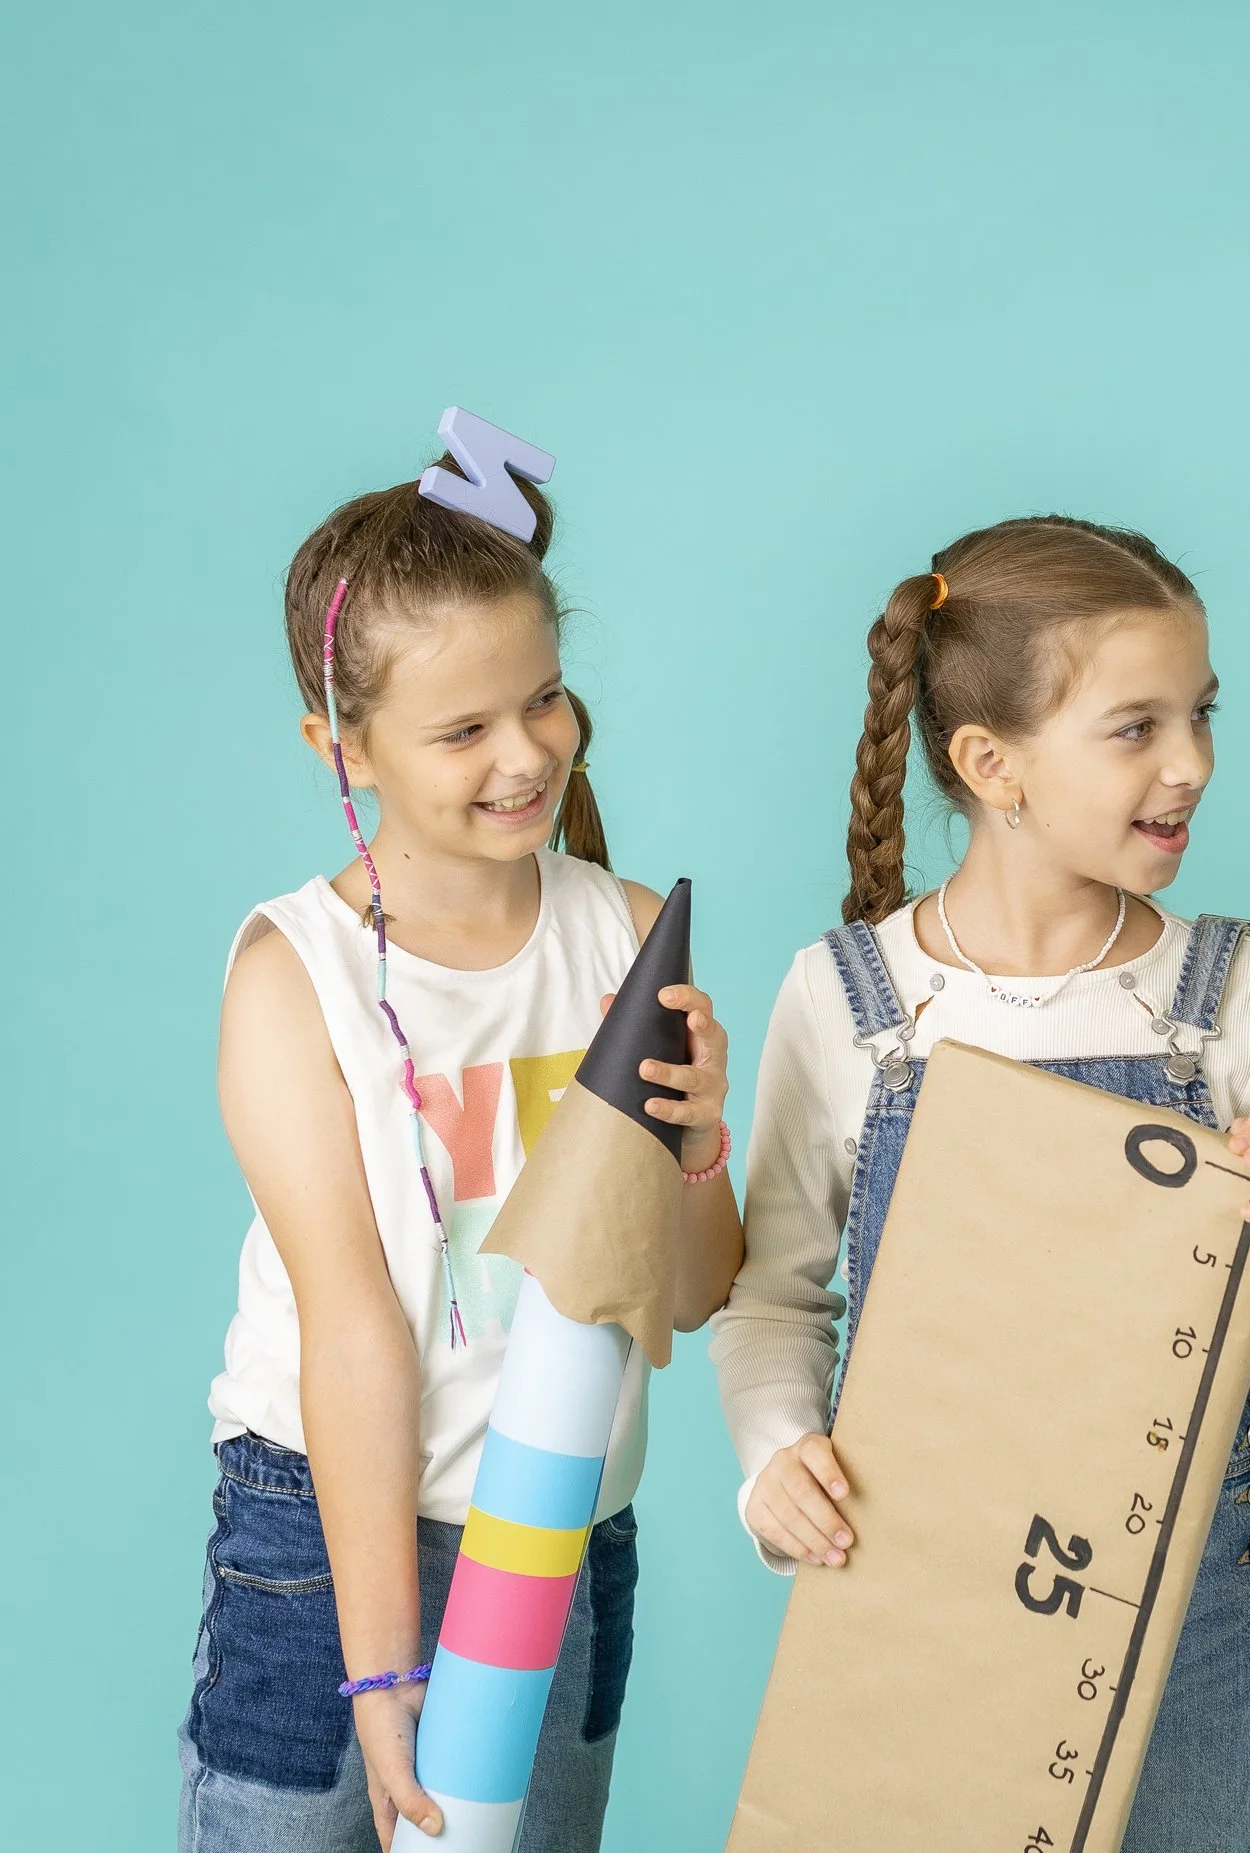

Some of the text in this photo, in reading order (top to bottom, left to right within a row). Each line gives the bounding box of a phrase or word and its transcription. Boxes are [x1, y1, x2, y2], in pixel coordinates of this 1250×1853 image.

[1193, 1245, 1217, 1267] 5
[1172, 1326, 1197, 1359] 10
[1126, 1493, 1152, 1534] 20
[1015, 1513, 1093, 1619] 25
[1077, 1658, 1105, 1700] 30
[1048, 1740, 1078, 1784] 35
